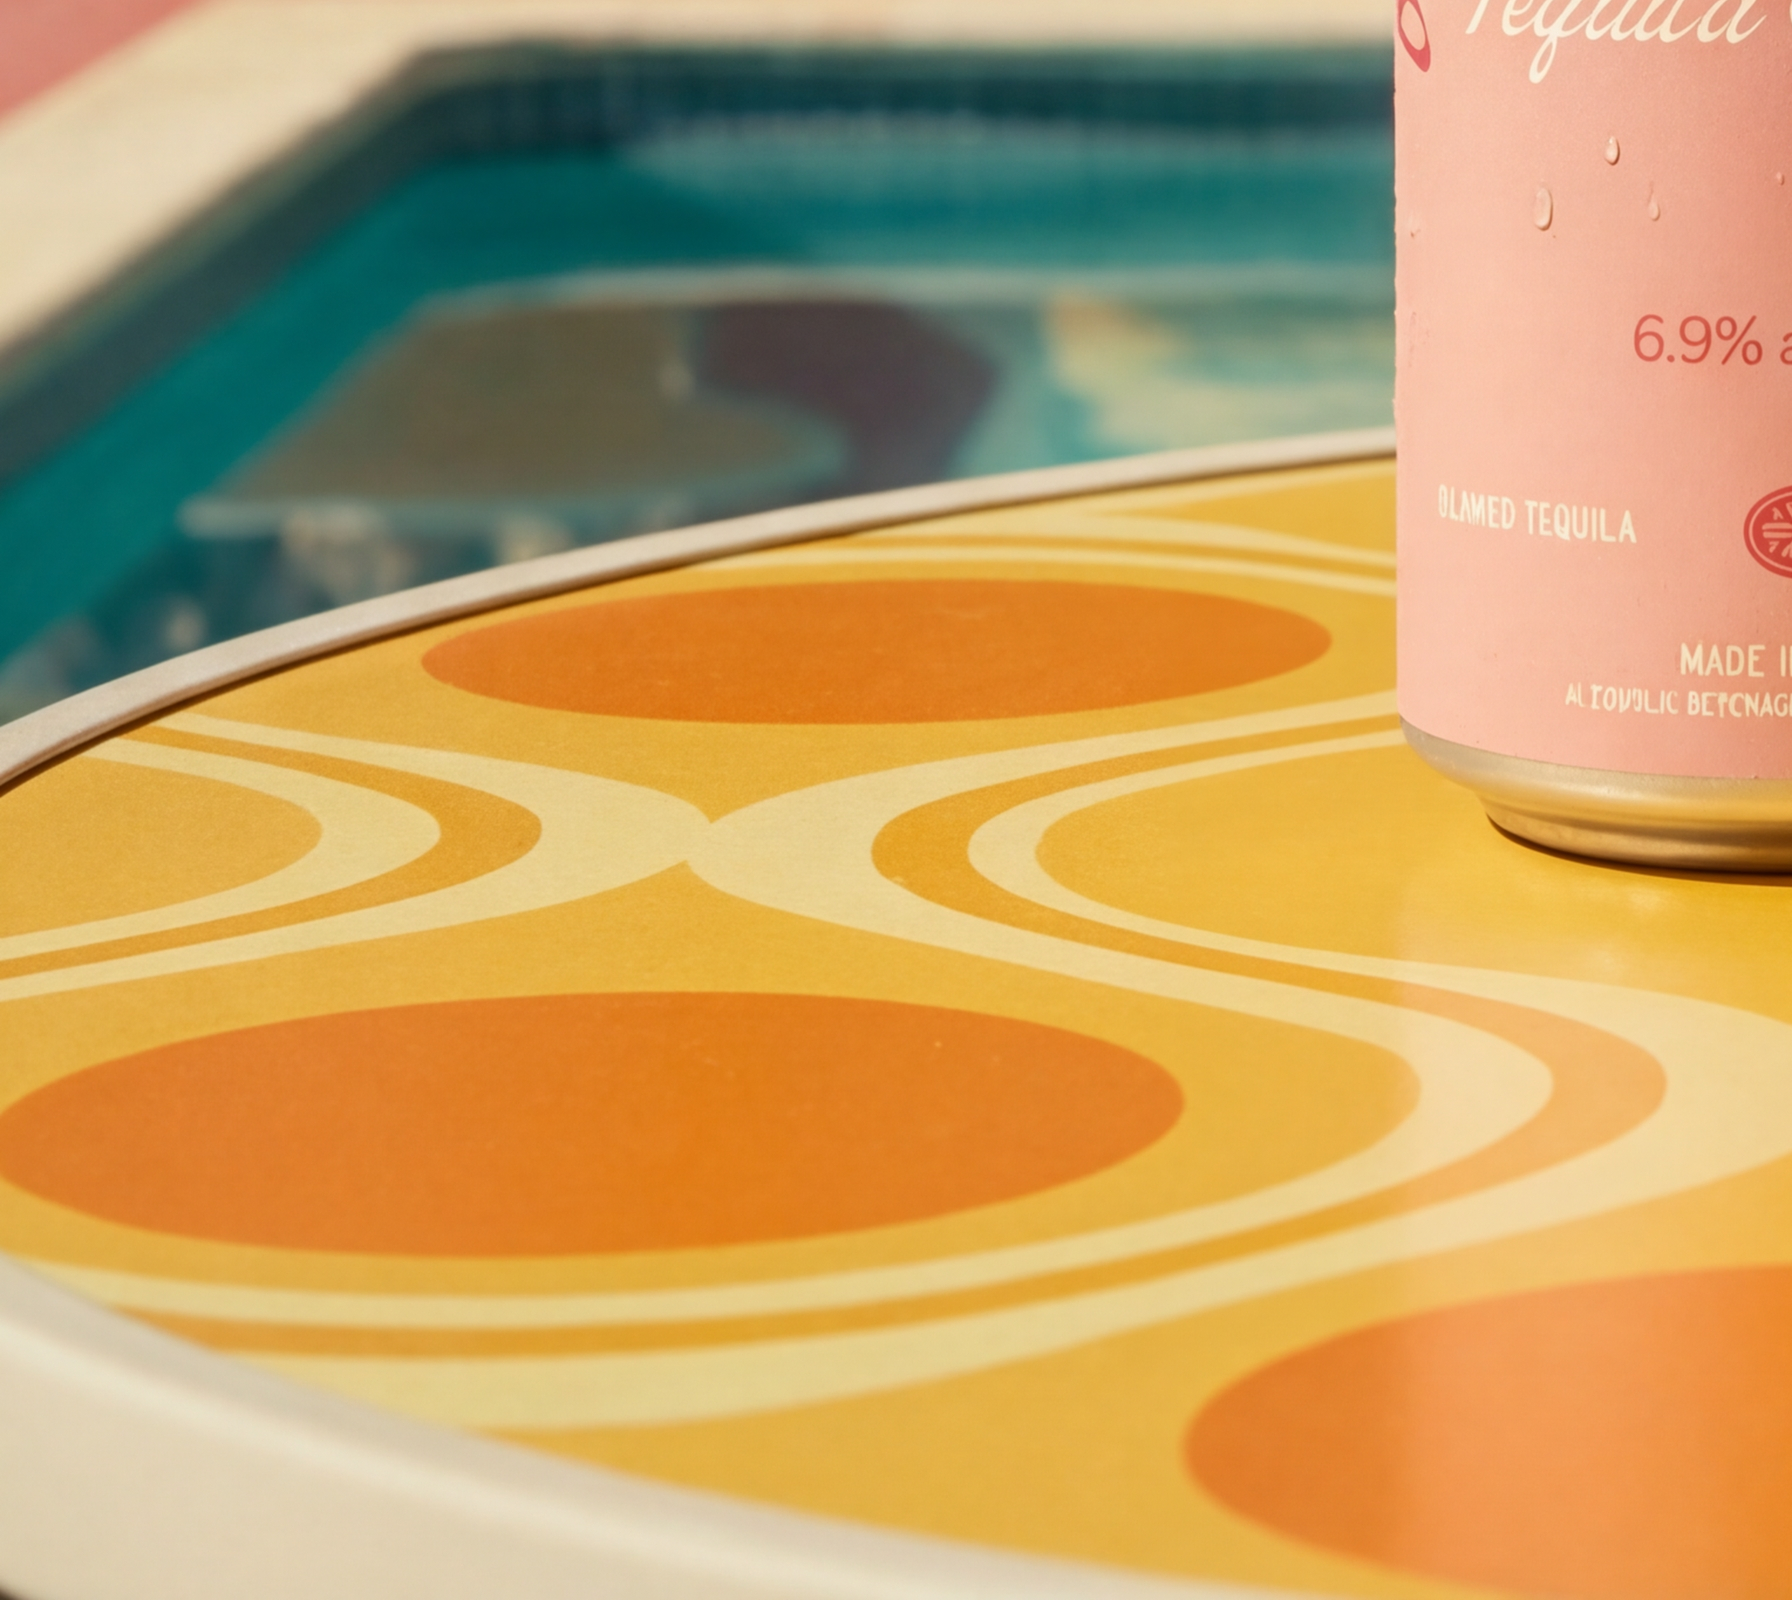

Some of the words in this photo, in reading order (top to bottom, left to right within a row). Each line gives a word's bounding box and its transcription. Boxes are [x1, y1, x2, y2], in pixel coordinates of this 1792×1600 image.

[1633, 313, 1764, 366] 6.9%
[1524, 499, 1638, 544] TEQUILA
[1679, 641, 1767, 678] MADE
